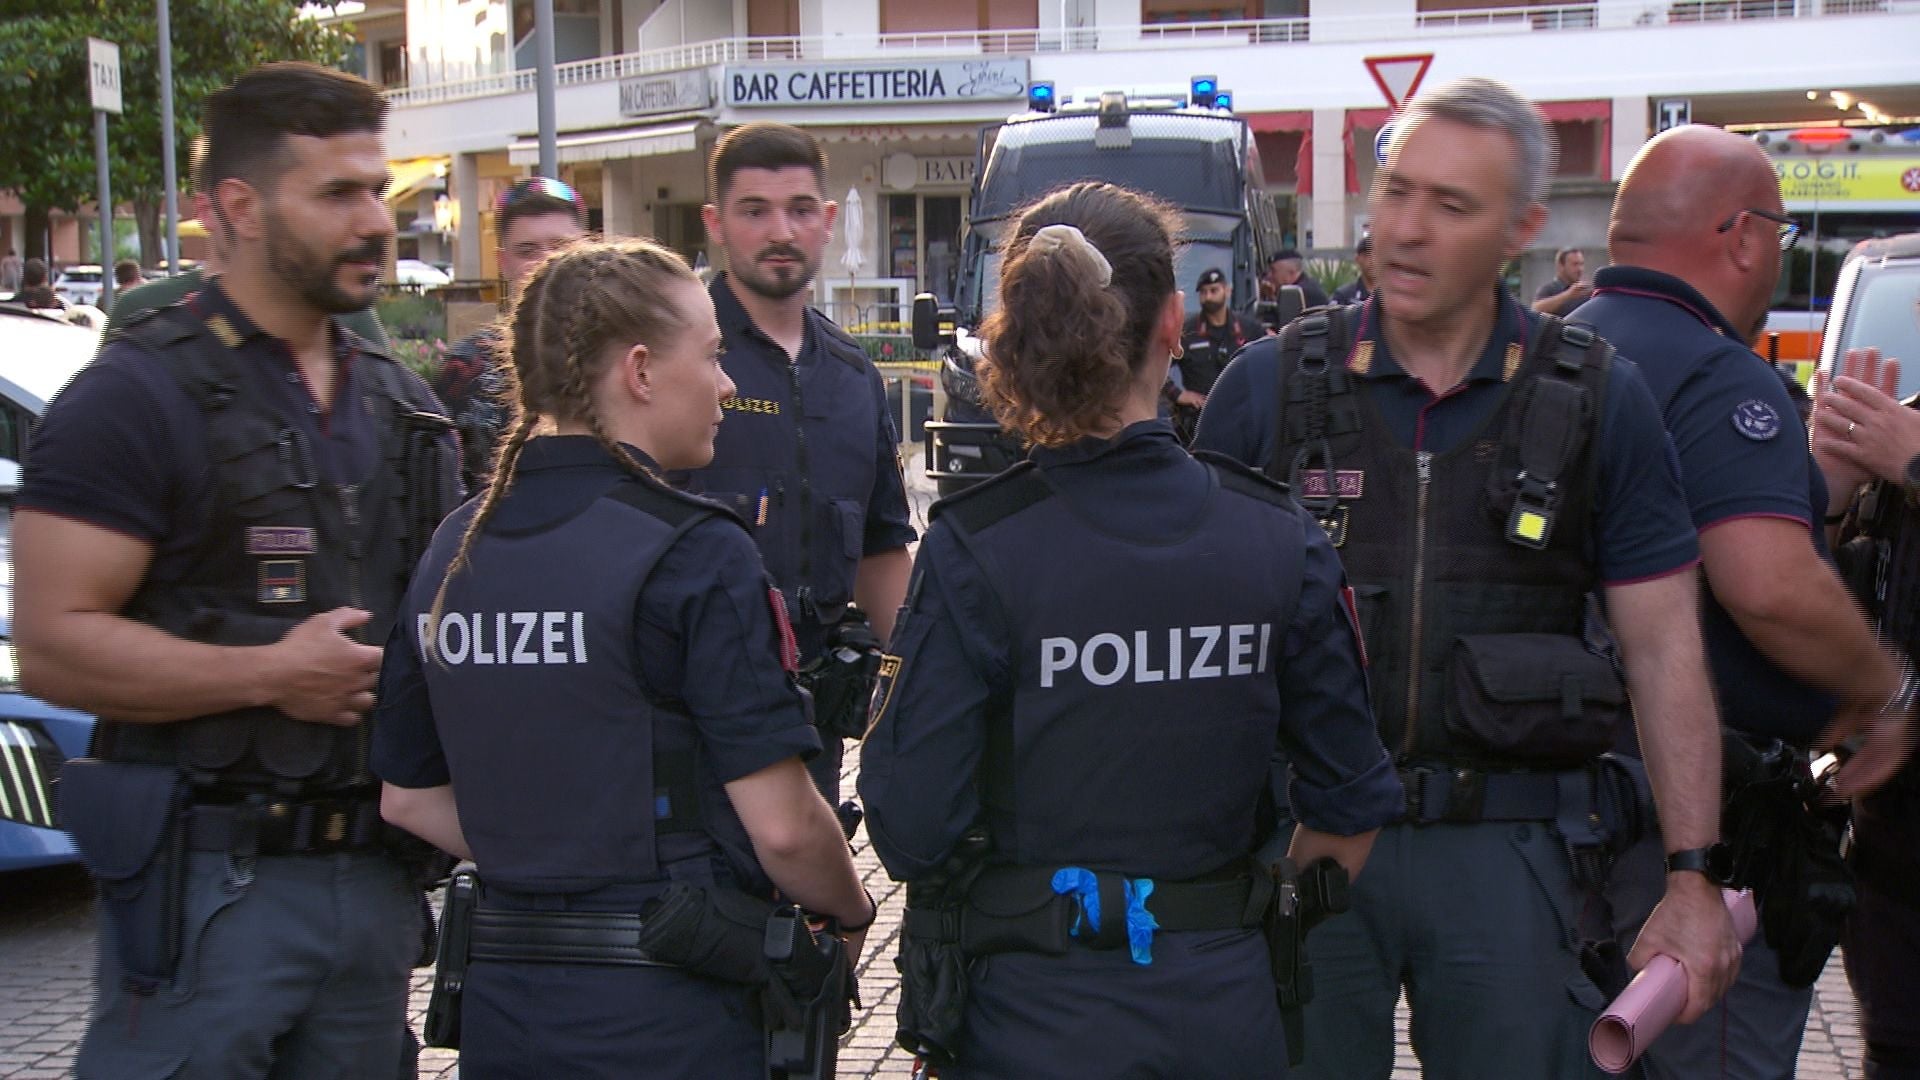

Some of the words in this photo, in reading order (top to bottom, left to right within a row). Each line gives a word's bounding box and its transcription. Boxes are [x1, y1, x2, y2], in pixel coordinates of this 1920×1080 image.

[94, 62, 119, 90] TAXI
[733, 73, 778, 101] BAR
[788, 69, 946, 98] CAFFETTERIA
[925, 160, 975, 181] BAR
[721, 397, 780, 415] OLIZEI
[1040, 623, 1271, 688] POLIZEI
